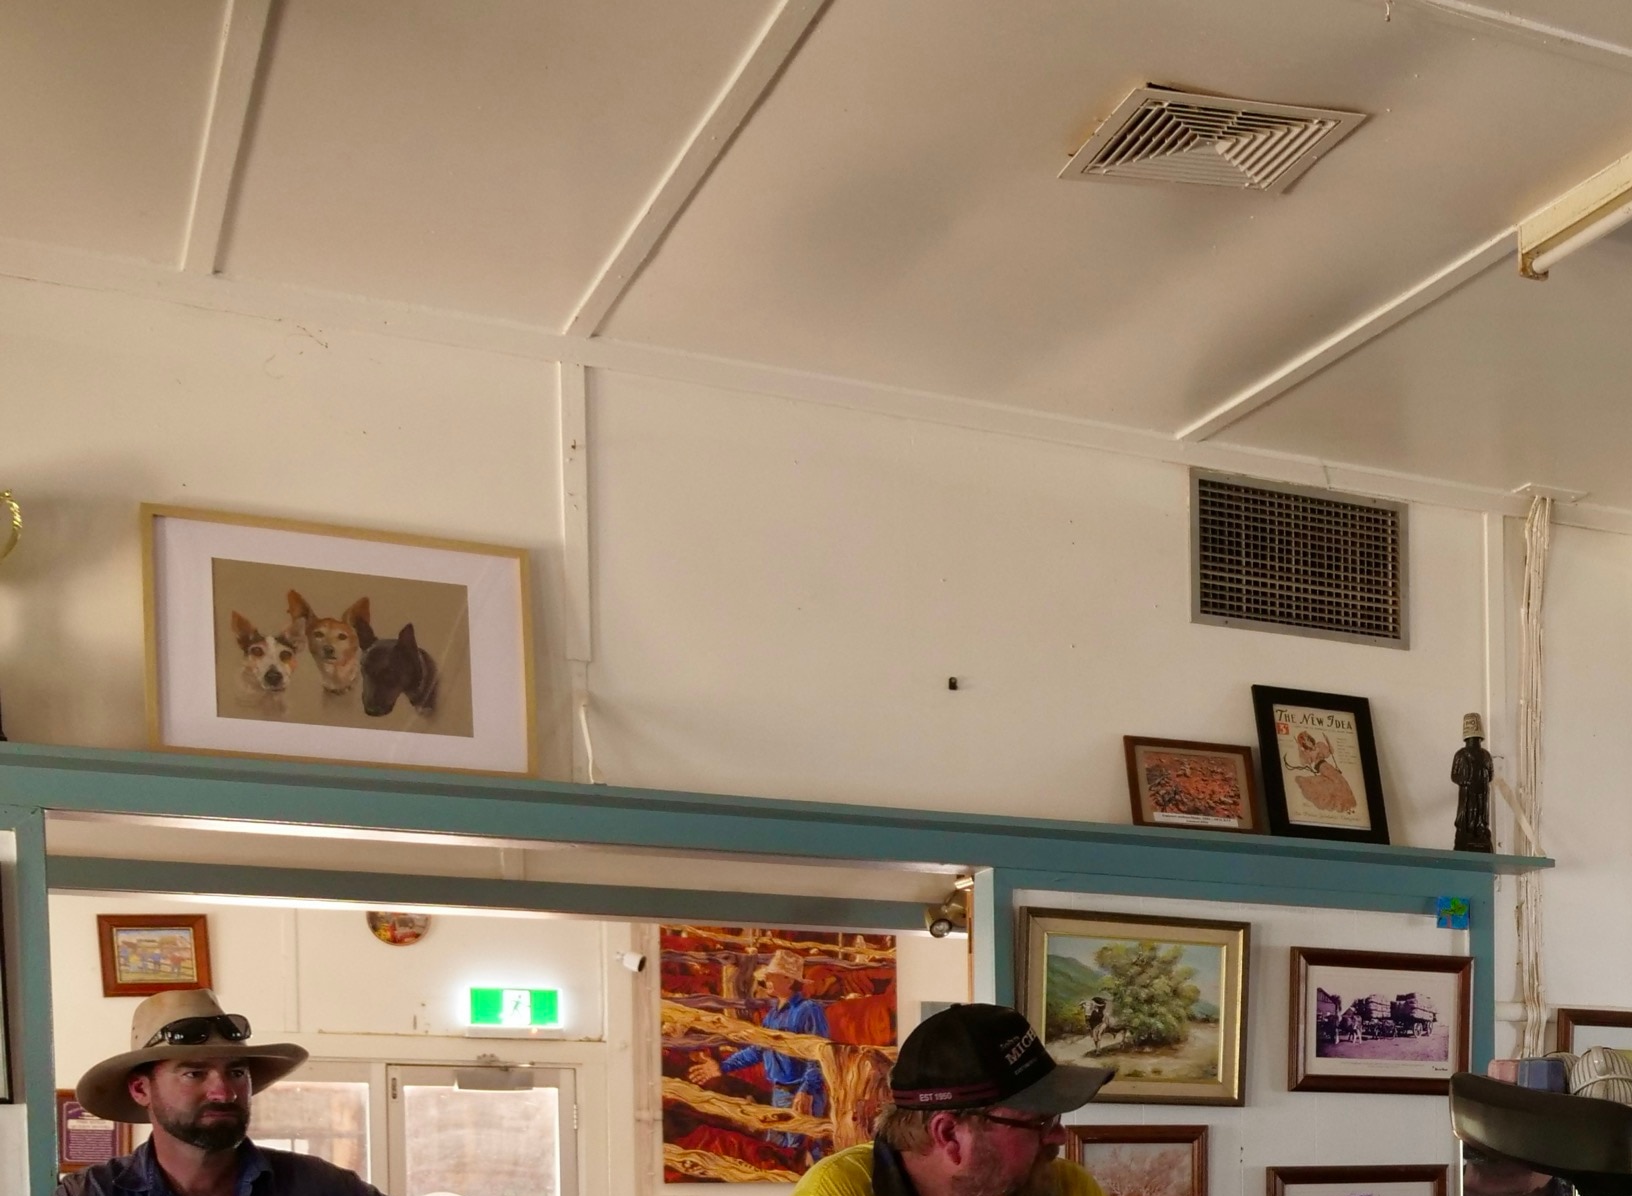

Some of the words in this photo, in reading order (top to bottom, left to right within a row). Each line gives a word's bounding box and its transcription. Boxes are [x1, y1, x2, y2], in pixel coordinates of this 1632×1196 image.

[1276, 708, 1297, 724] THE
[1300, 713, 1325, 728] NEW
[1326, 714, 1354, 731] IDEA
[919, 1093, 933, 1102] EST
